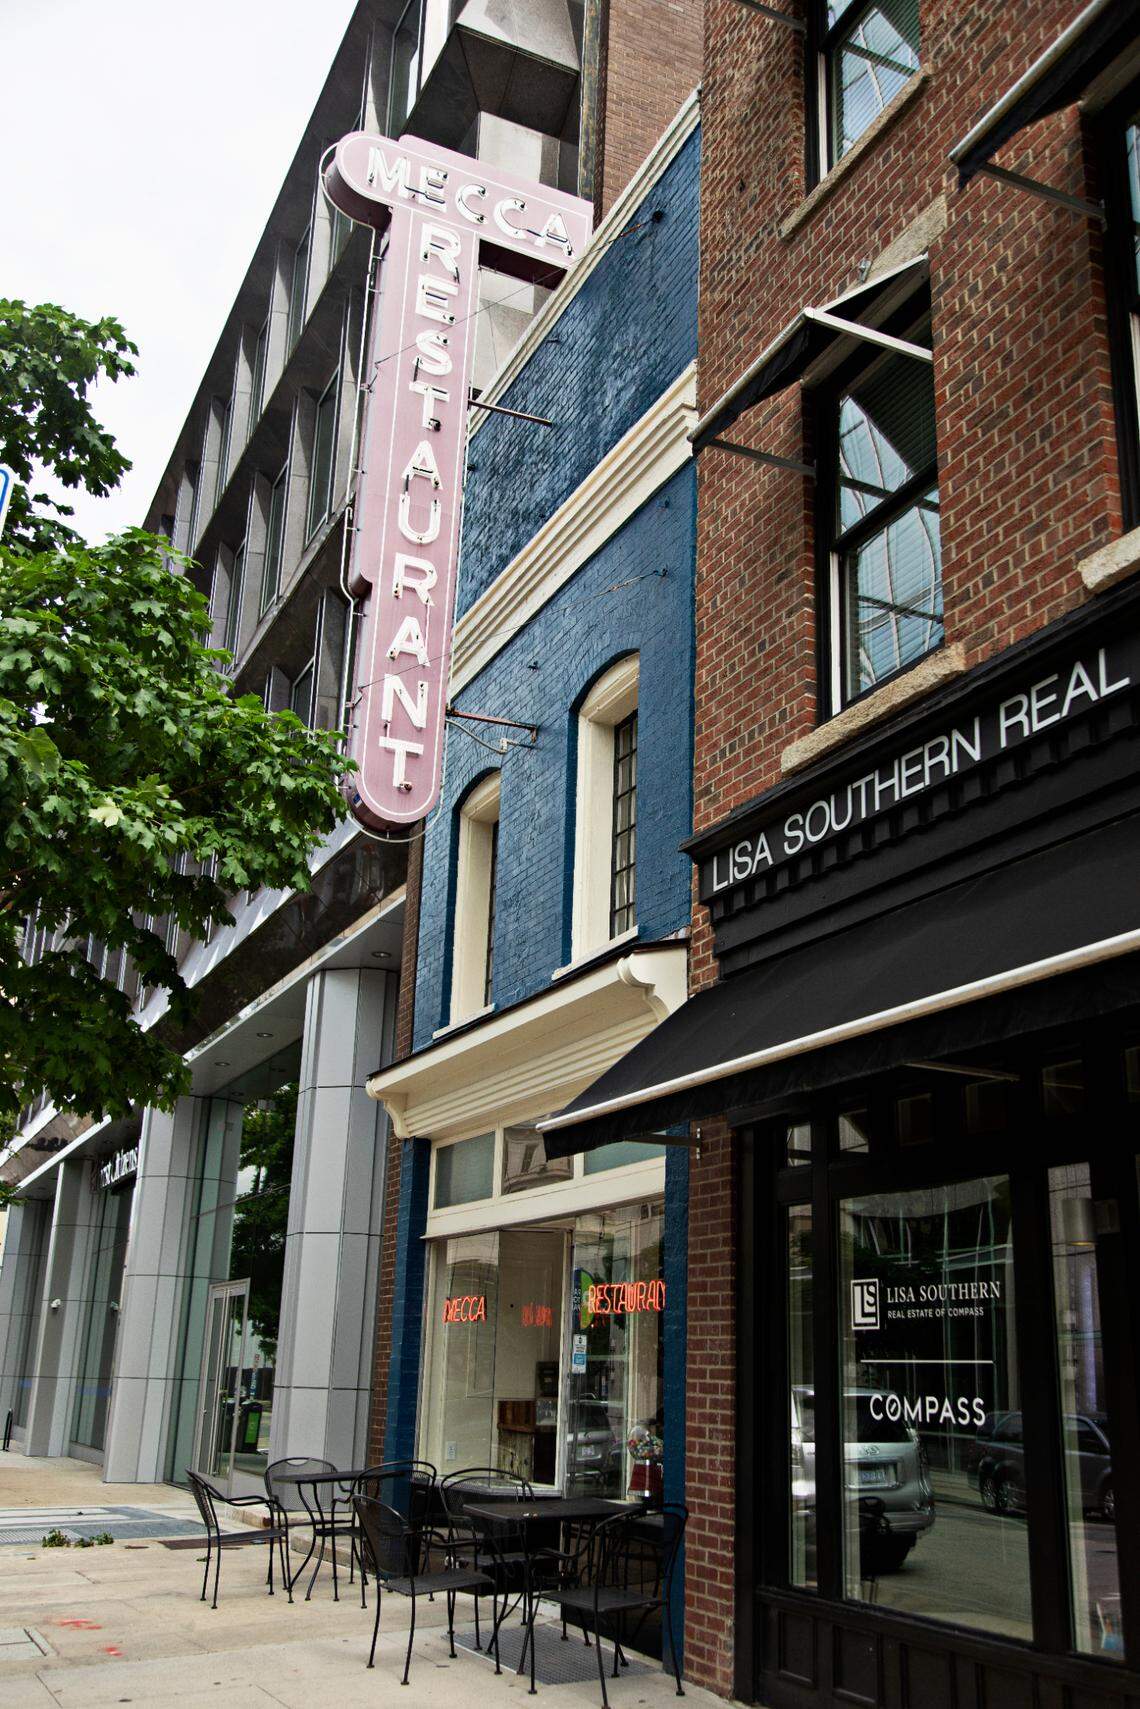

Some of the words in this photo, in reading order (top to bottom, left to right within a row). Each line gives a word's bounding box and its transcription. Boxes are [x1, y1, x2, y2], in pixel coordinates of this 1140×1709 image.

[366, 146, 574, 257] MECCA
[379, 222, 462, 789] RESTAURANT
[712, 831, 774, 892] LISA
[783, 716, 981, 856] SOUTHERN
[1000, 648, 1131, 749] REAL
[887, 1287, 915, 1303] LISA
[920, 1281, 1001, 1302] SOUTHERN
[442, 1295, 486, 1324] MECCA
[887, 1310, 905, 1319] REAL
[907, 1308, 933, 1319] ESTATE
[935, 1307, 945, 1318] OF
[948, 1306, 984, 1317] COMPASS
[870, 1394, 986, 1426] COMPASS
